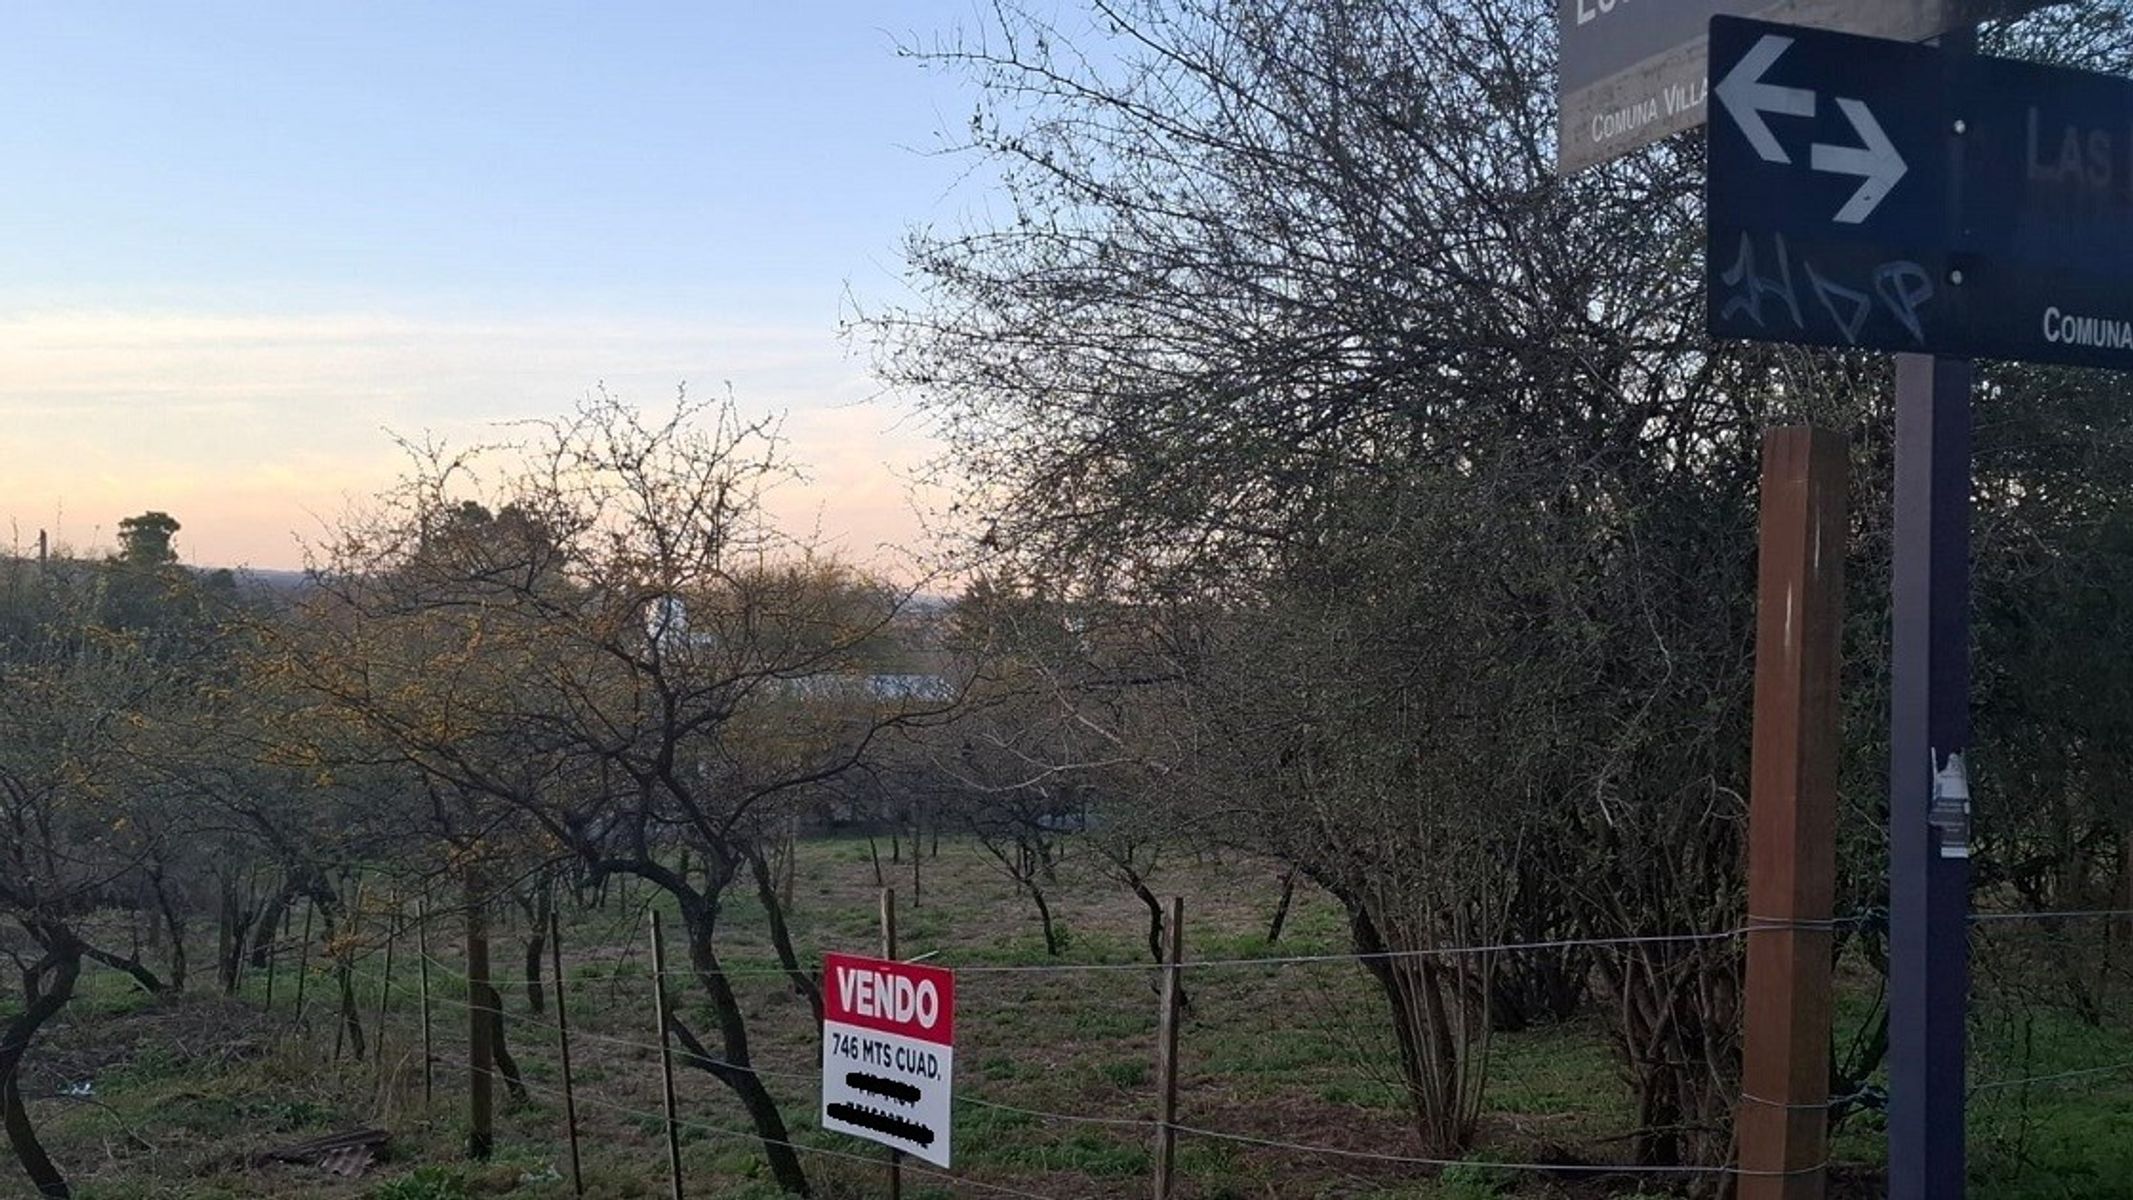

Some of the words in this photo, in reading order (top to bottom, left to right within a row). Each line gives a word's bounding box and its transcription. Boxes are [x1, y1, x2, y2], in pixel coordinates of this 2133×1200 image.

[1592, 98, 1658, 142] COMUNA
[2027, 106, 2112, 188] LAS
[2044, 306, 2133, 349] COMUNA
[836, 966, 939, 1029] VENDO
[832, 1033, 858, 1060] 746
[862, 1038, 892, 1068] MTS
[895, 1046, 941, 1081] CUAD.
